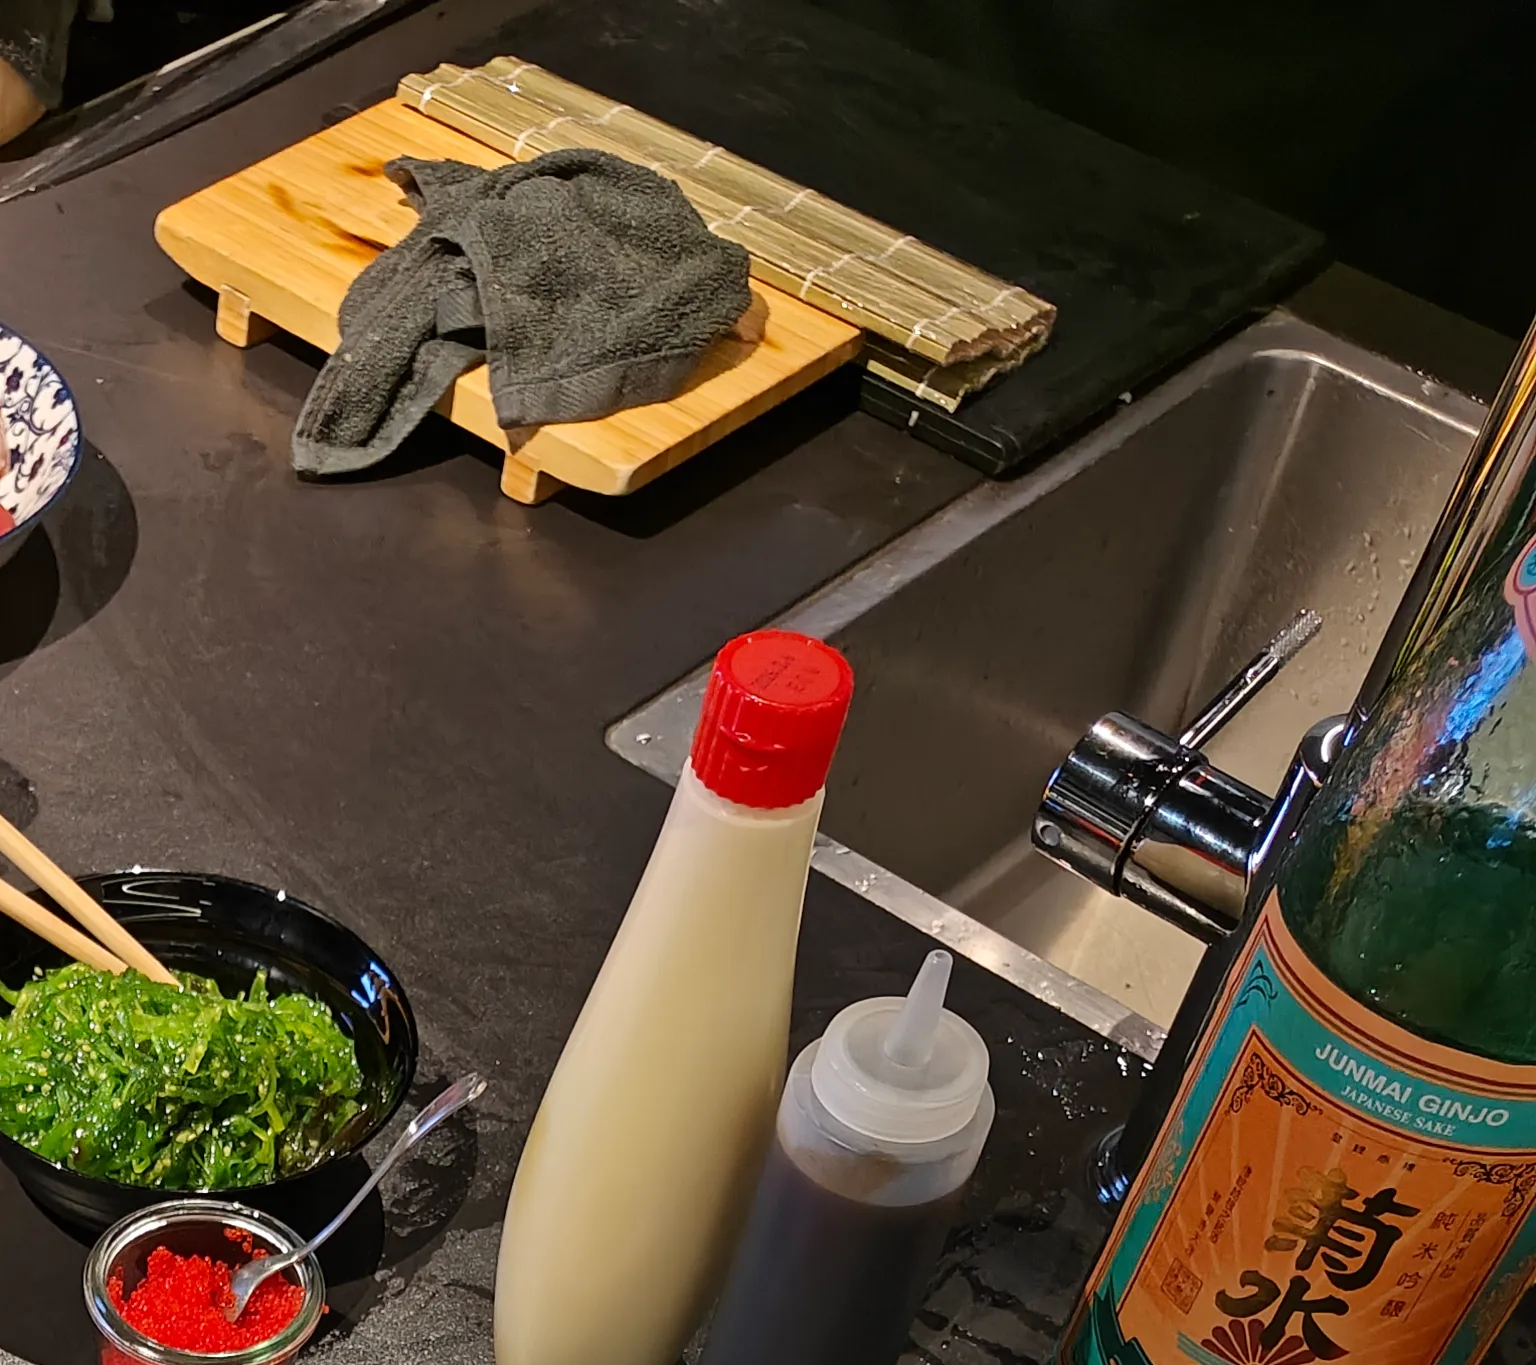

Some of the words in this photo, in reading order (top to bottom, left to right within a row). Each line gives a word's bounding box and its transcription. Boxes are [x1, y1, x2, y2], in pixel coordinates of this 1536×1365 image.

[1315, 1043, 1413, 1105] JUNMAI
[1418, 1094, 1511, 1127] GINJO
[1340, 1085, 1413, 1125] JAPANESE
[1413, 1115, 1457, 1138] SAKE
[1214, 1166, 1421, 1362] 菊水
